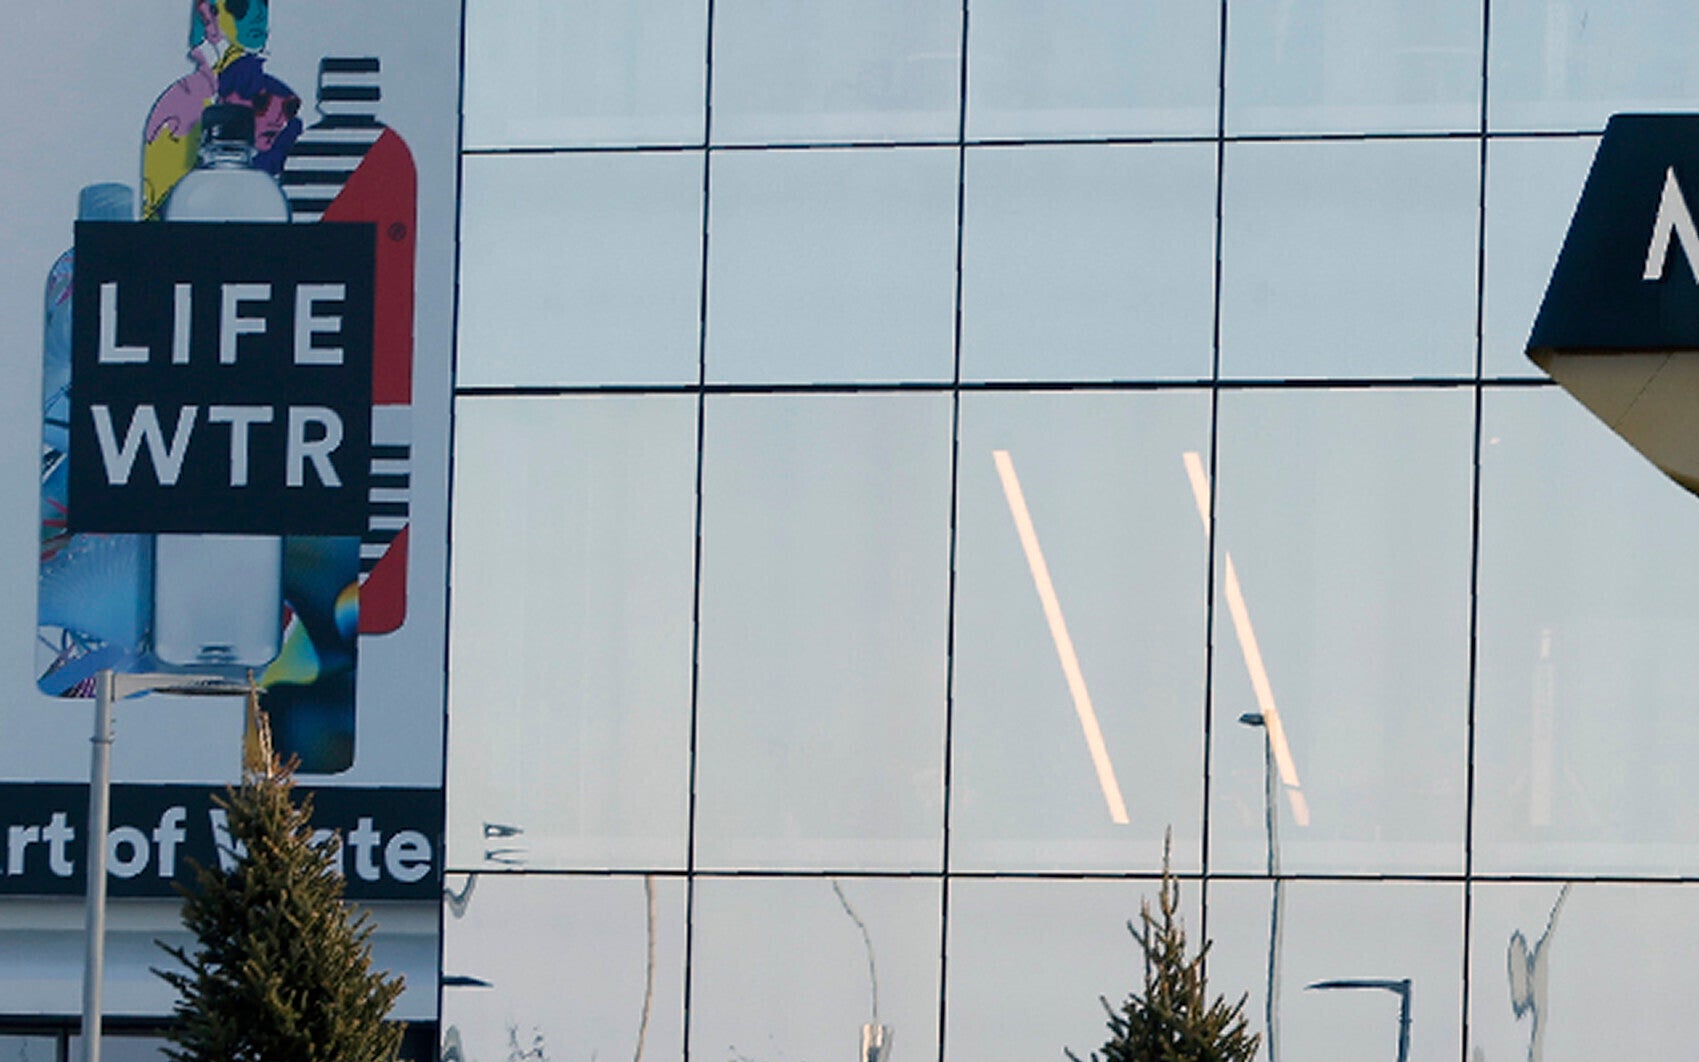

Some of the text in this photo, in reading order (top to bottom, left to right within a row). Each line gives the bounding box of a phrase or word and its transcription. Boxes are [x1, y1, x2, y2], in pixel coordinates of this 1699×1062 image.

[98, 282, 346, 364] LIFE
[90, 404, 344, 487] WTR
[0, 812, 76, 877] rt
[107, 806, 187, 879] of
